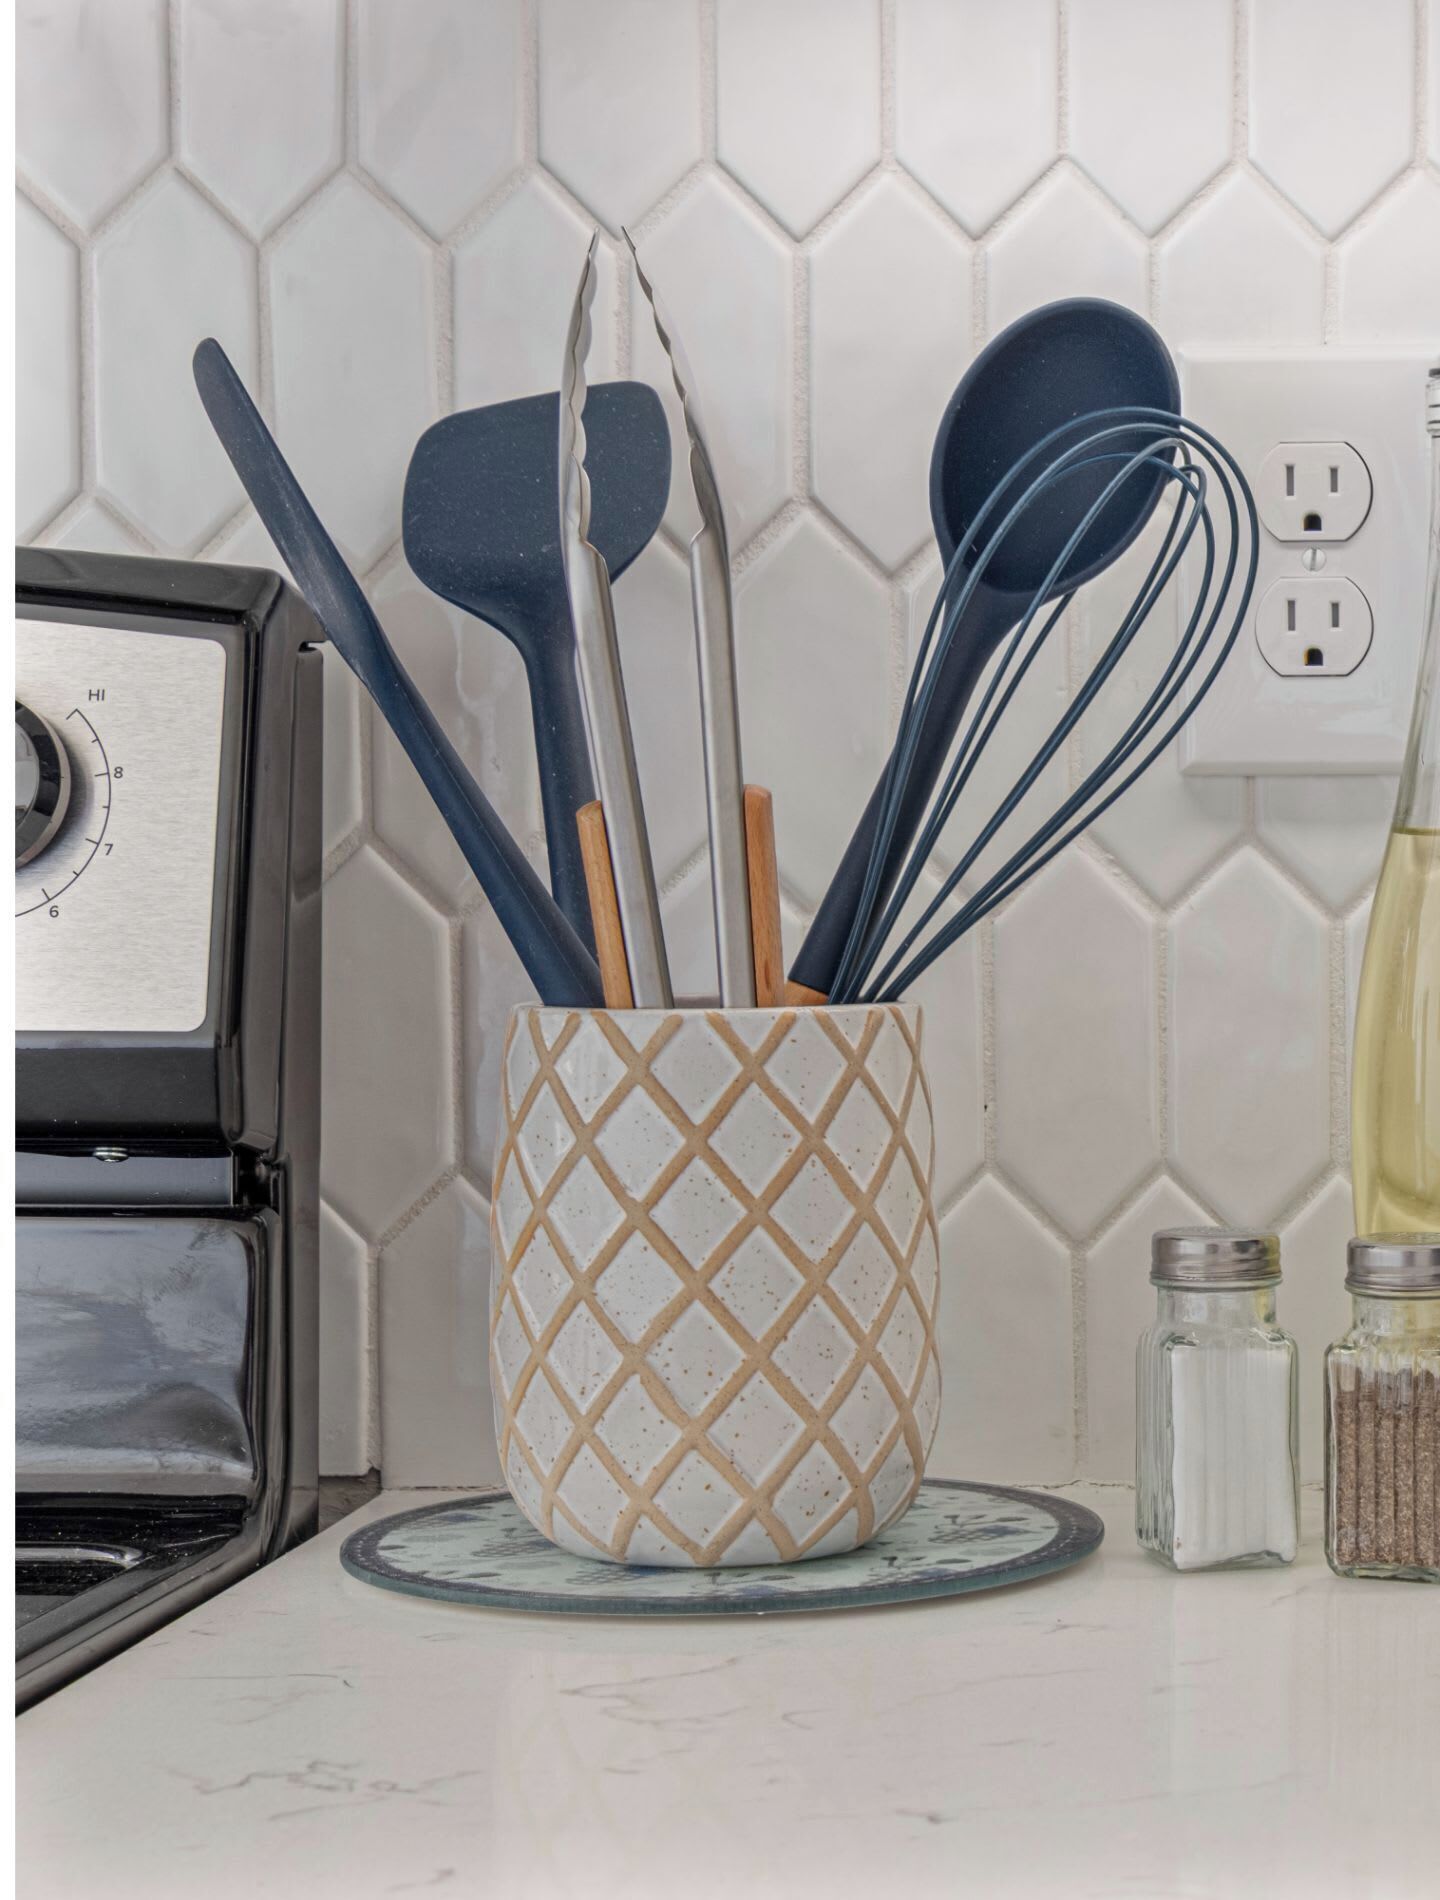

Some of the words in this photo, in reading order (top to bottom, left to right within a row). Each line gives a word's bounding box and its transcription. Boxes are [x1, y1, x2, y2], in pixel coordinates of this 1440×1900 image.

[88, 689, 105, 701] HI
[114, 766, 123, 779] 8
[105, 843, 113, 856] 7
[49, 905, 59, 918] 6
